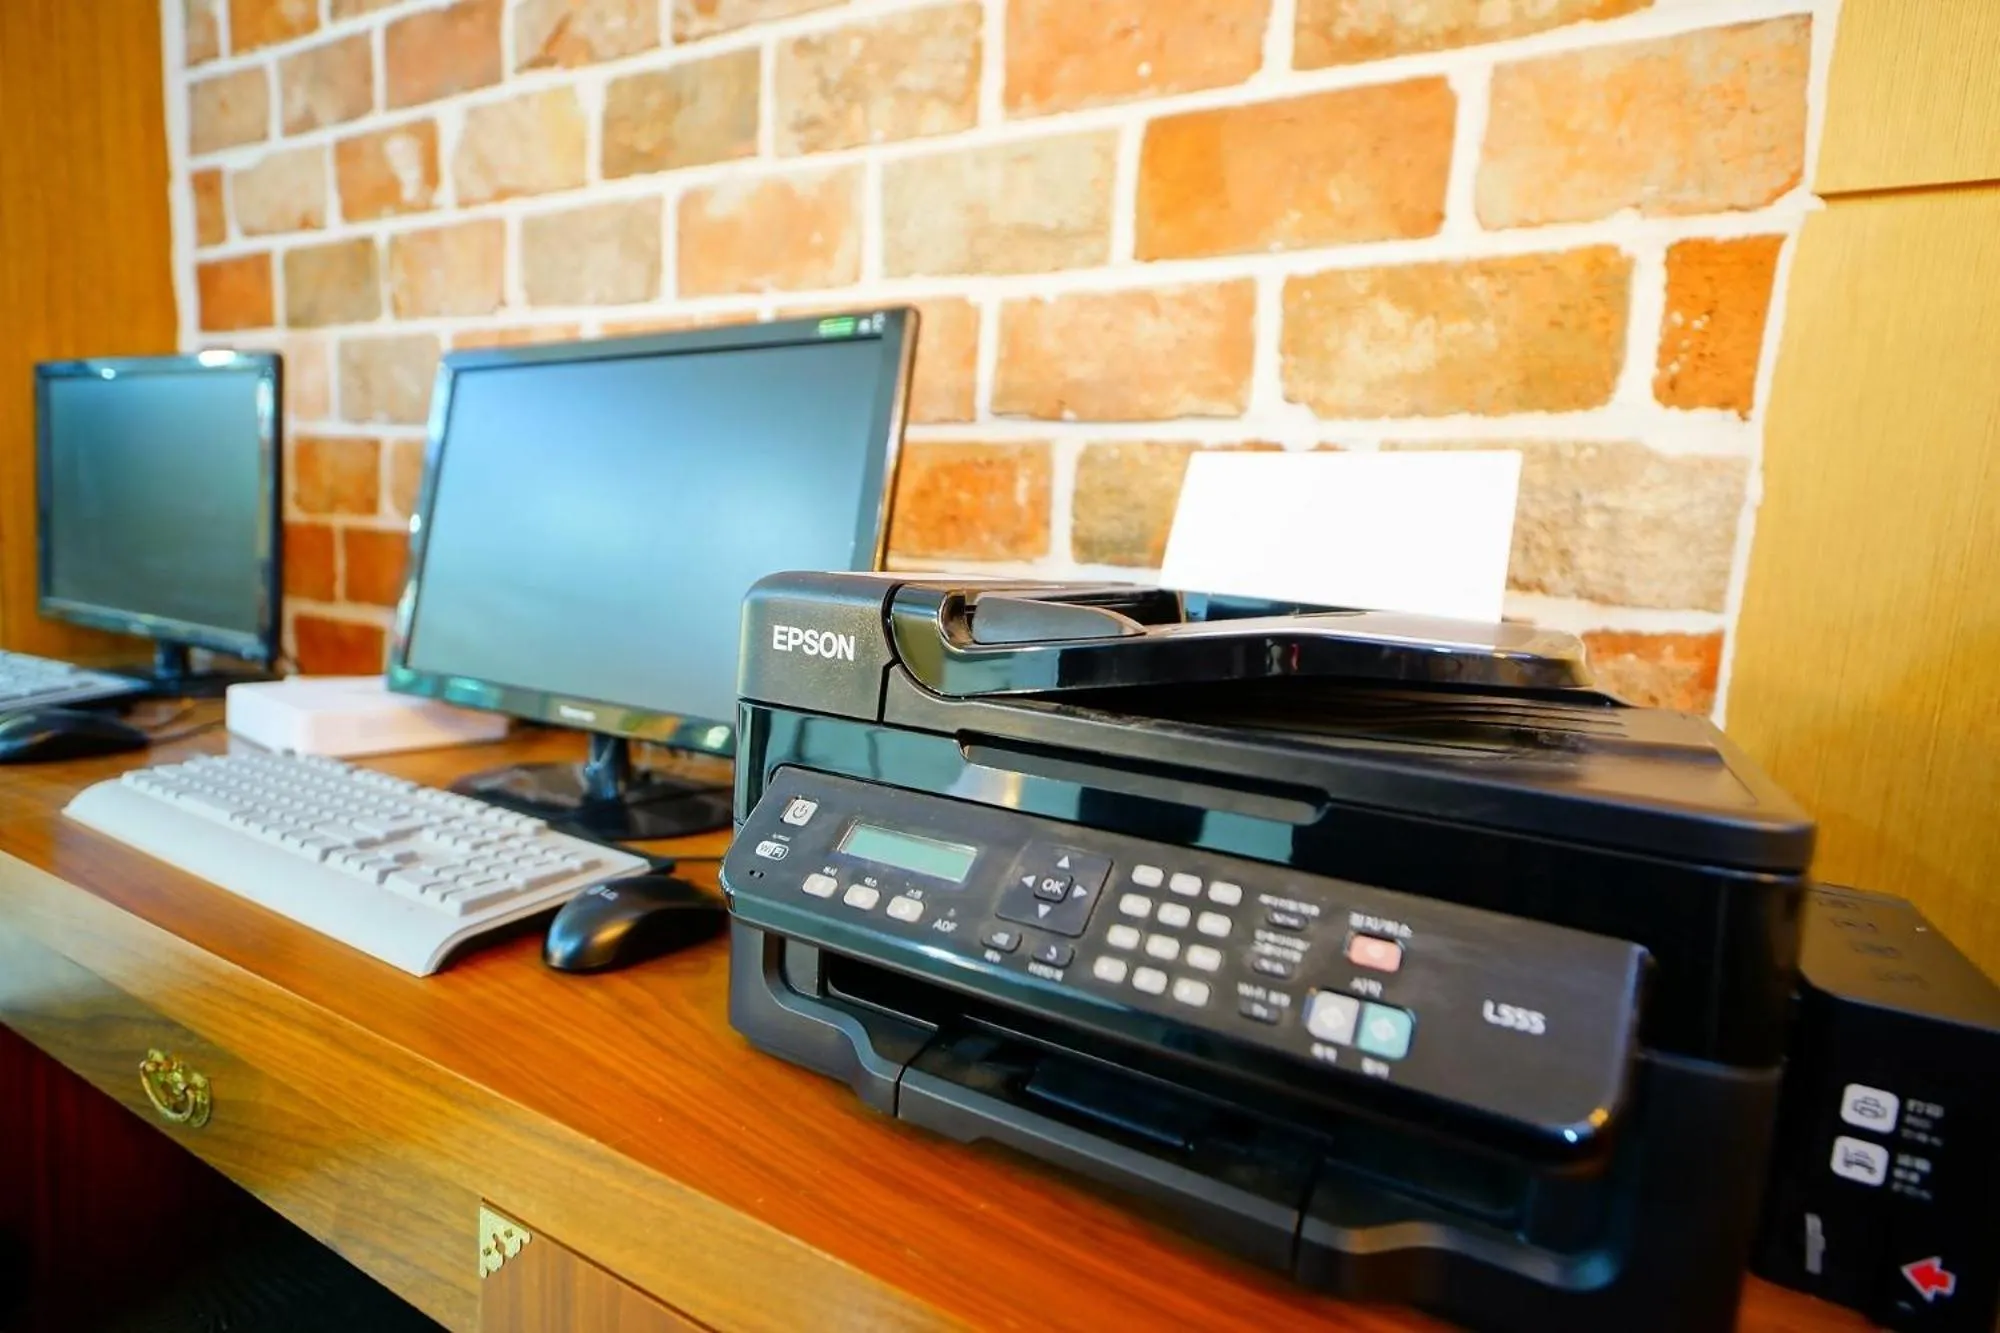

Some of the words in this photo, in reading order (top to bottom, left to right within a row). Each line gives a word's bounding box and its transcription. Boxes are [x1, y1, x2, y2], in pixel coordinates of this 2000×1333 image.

[773, 625, 855, 661] EPSON
[1042, 878, 1065, 894] OK
[932, 918, 958, 933] ADF
